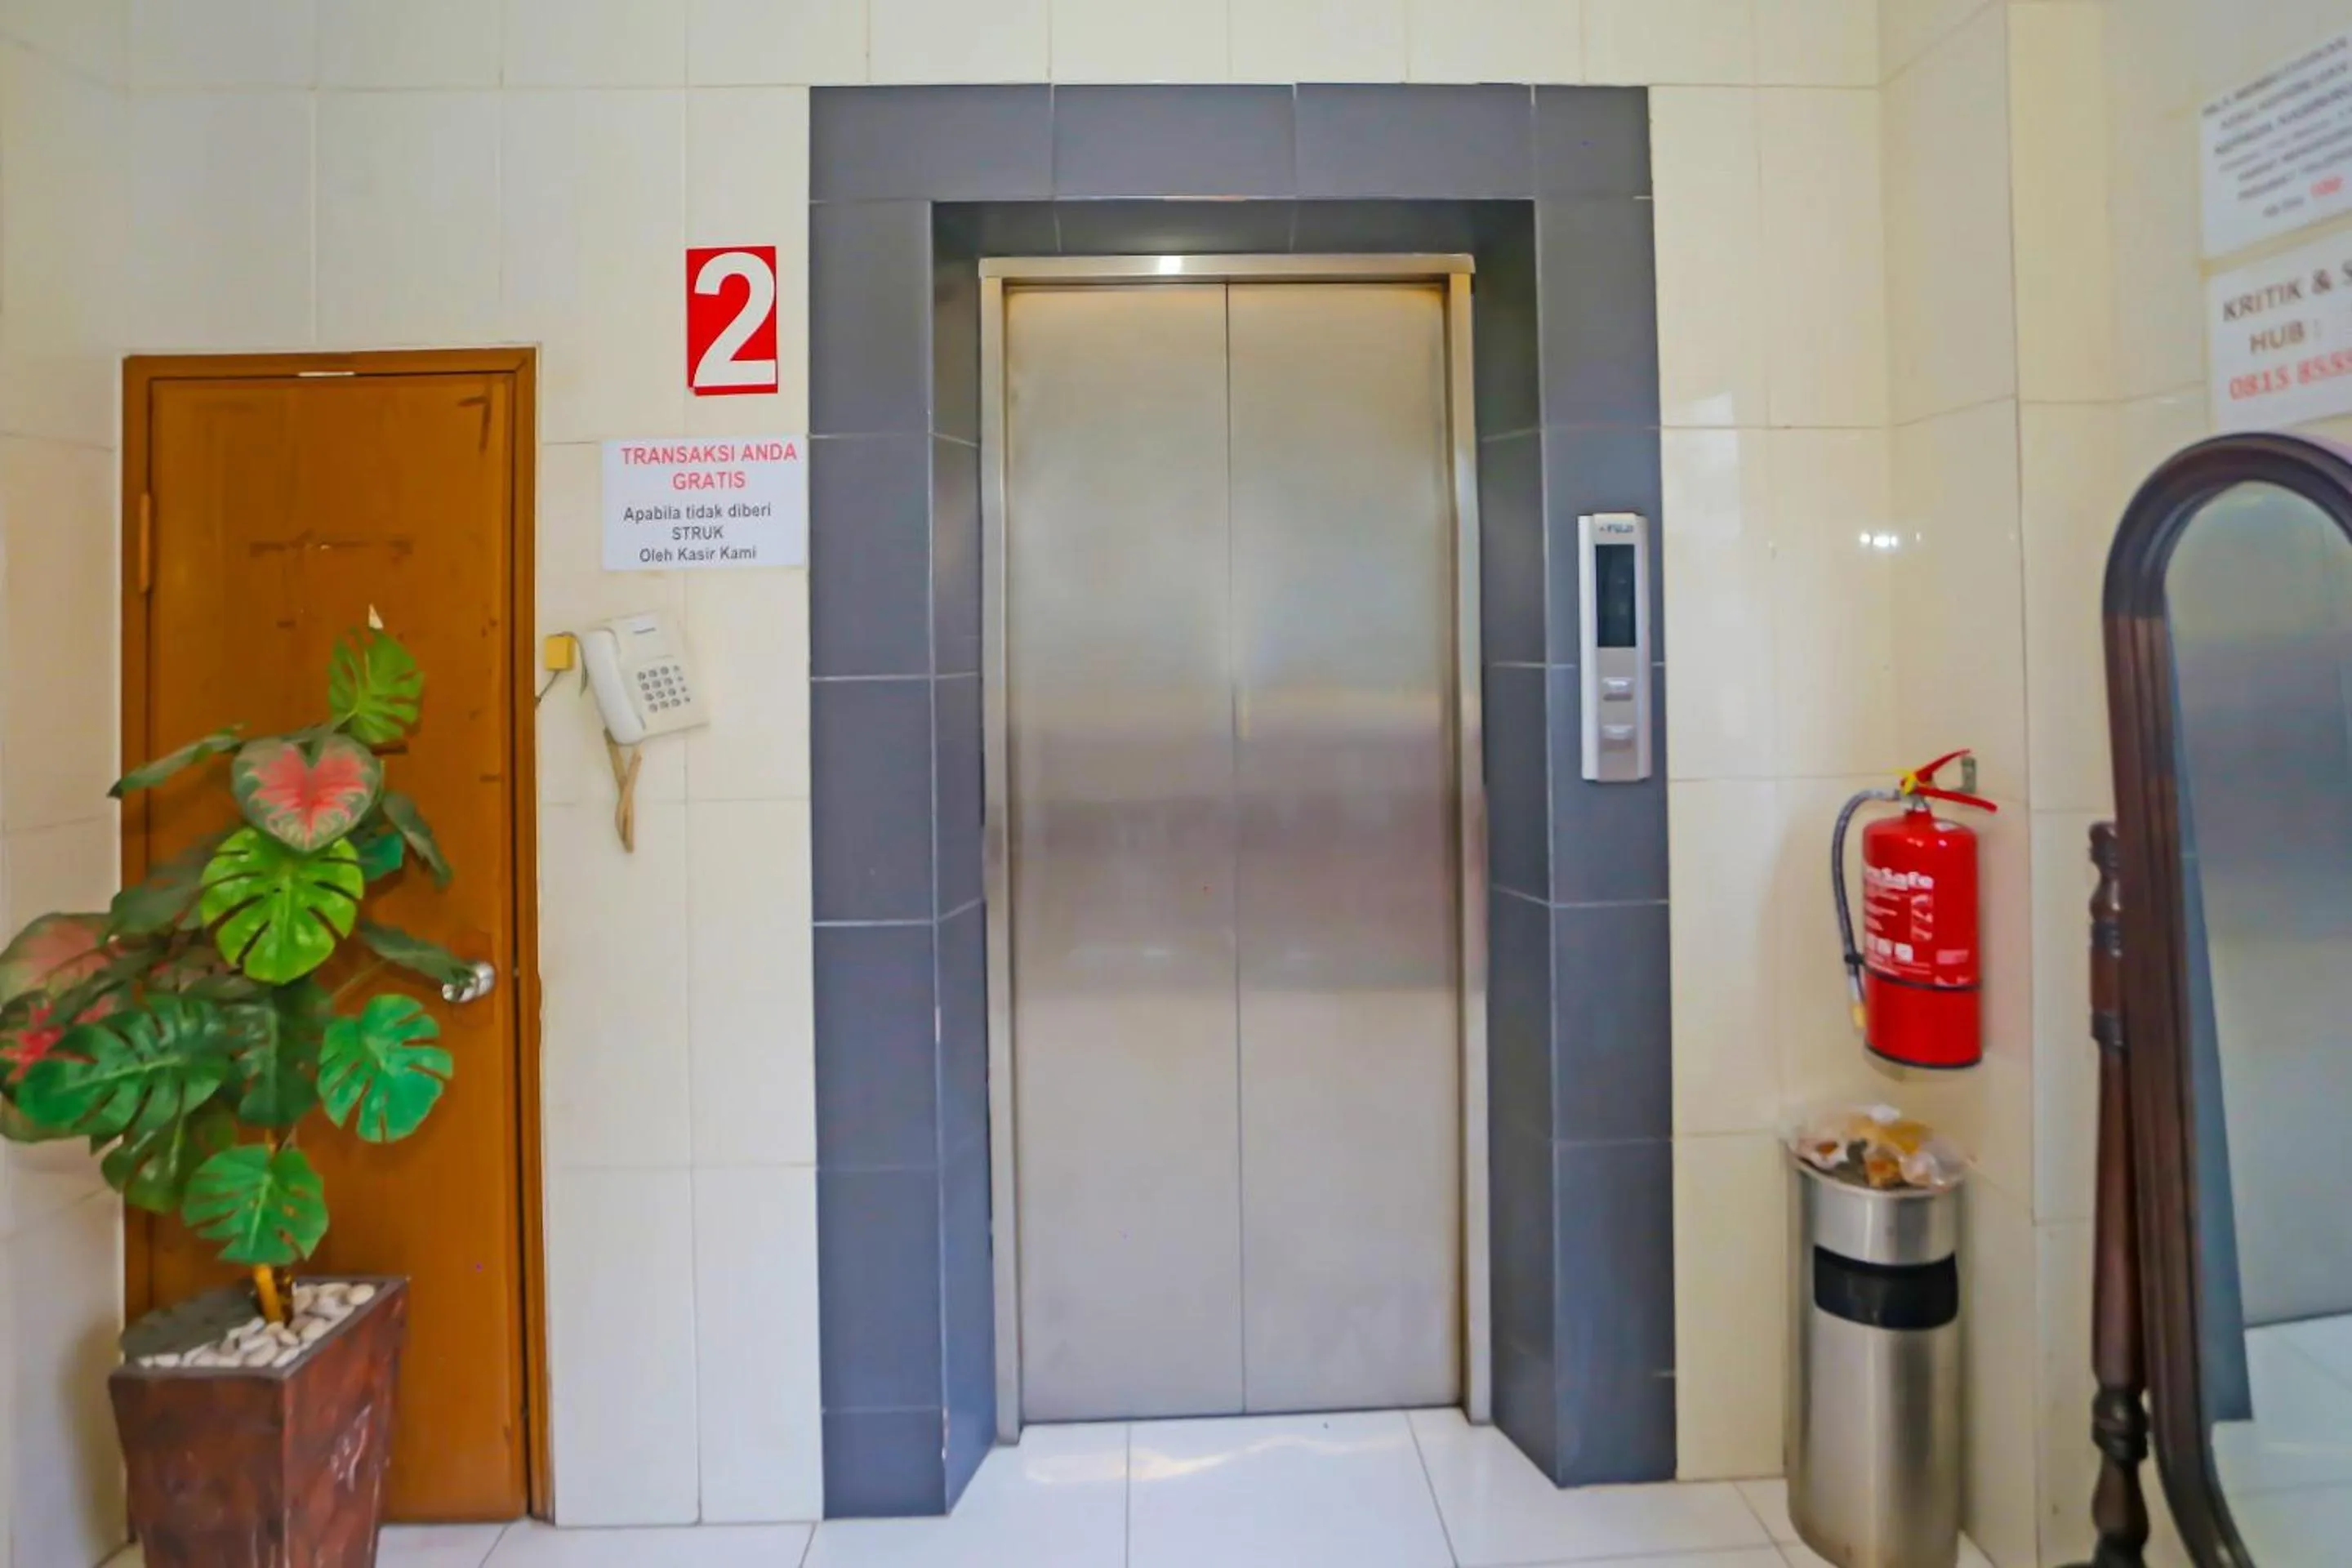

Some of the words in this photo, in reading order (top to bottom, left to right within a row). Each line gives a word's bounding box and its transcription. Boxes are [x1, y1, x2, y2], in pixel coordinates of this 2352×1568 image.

[2223, 278, 2303, 322] KRITIK
[2311, 268, 2332, 295] &
[693, 252, 776, 385] 2
[2250, 321, 2305, 354] HUB
[621, 444, 735, 465] TRANSAKSI
[741, 443, 797, 462] ANDA
[673, 471, 746, 490] GRATIS
[624, 505, 681, 523] Apabila
[686, 504, 723, 519] tidak
[728, 502, 772, 519] diberi
[672, 525, 724, 541] STRUK
[639, 548, 673, 563] Oleh
[677, 547, 716, 561] Kasir
[719, 546, 757, 560] Kami
